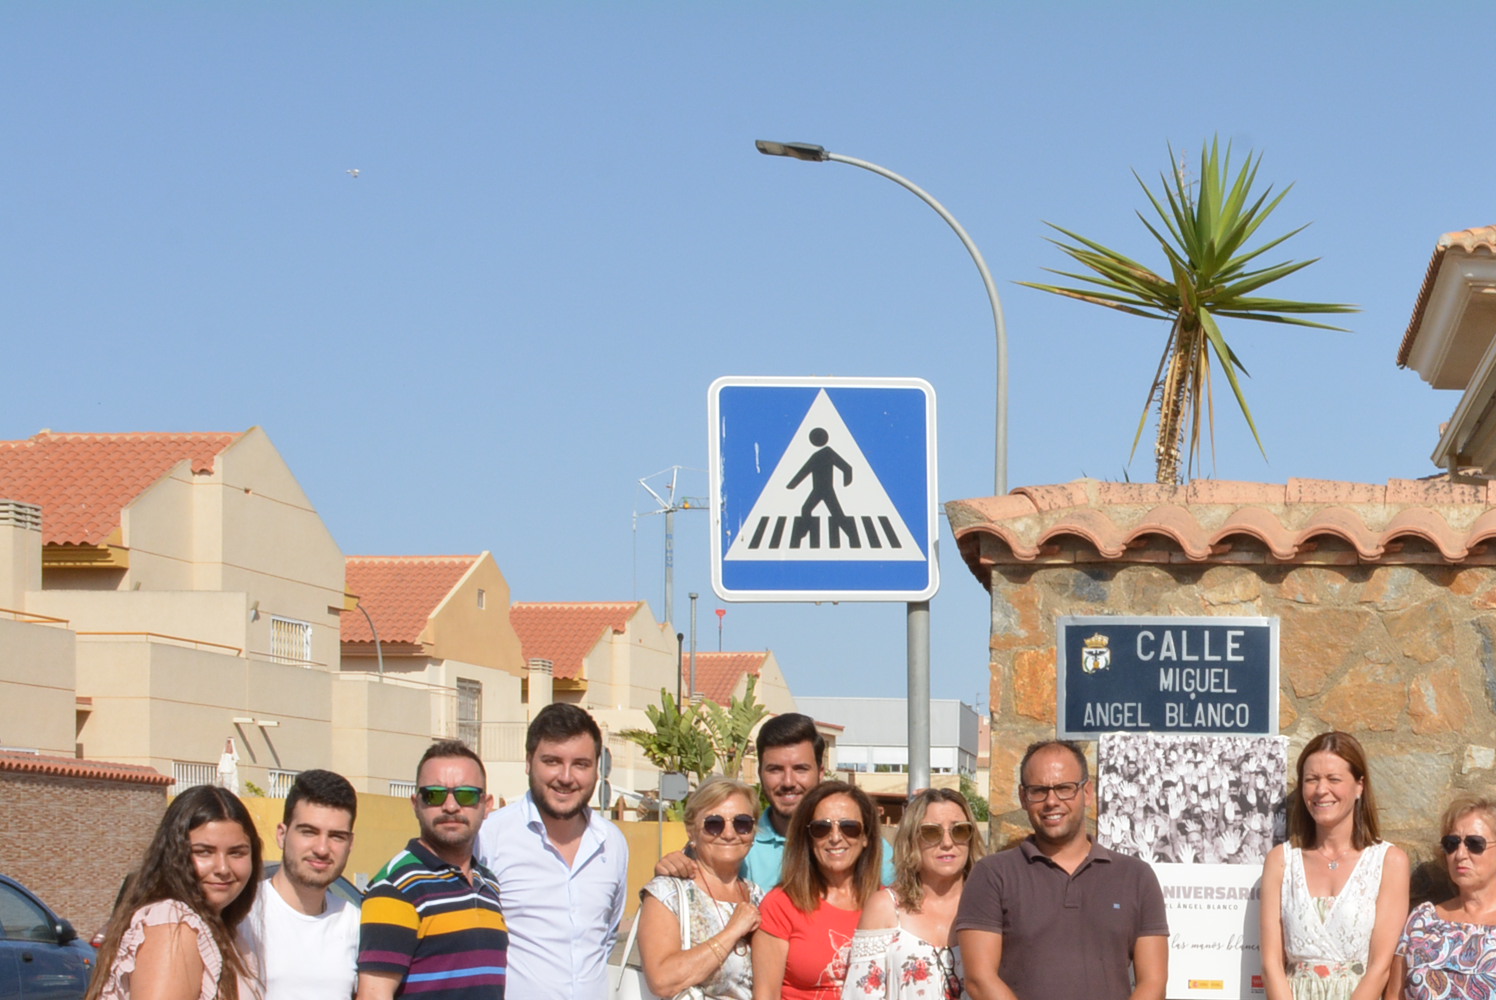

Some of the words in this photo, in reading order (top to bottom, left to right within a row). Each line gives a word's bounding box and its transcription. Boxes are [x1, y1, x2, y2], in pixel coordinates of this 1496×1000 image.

[1136, 630, 1245, 662] CALLE
[1159, 668, 1238, 694] MIGUEL
[1083, 702, 1150, 728] ANGEL
[1165, 703, 1250, 728] BLANCO
[1163, 885, 1261, 900] NIVERSARI
[1207, 903, 1239, 911] BLANCO
[1226, 934, 1261, 951] blanca
